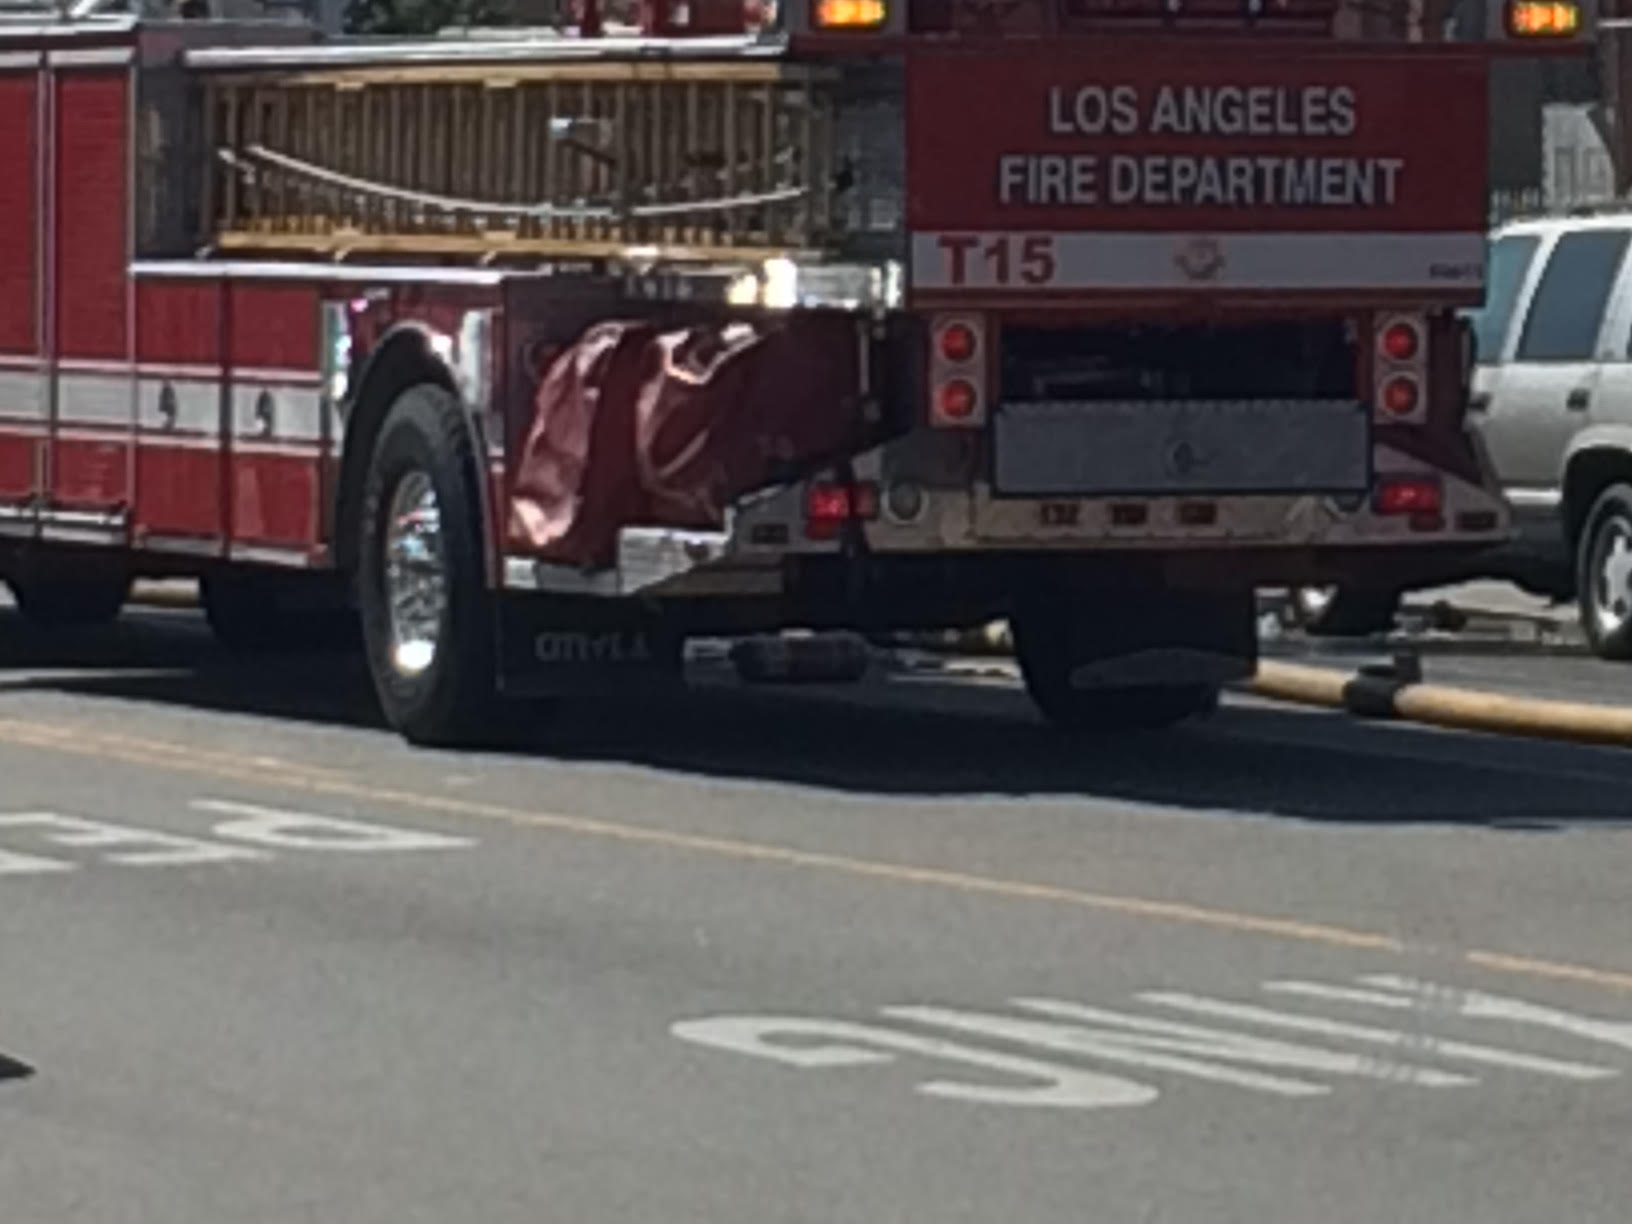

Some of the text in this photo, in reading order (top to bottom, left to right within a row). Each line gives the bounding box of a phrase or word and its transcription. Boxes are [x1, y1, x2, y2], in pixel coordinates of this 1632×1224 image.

[1049, 86, 1356, 134] LOS ANGELES
[999, 155, 1404, 205] FIRE DEPARTMENT
[937, 234, 1057, 285] T15
